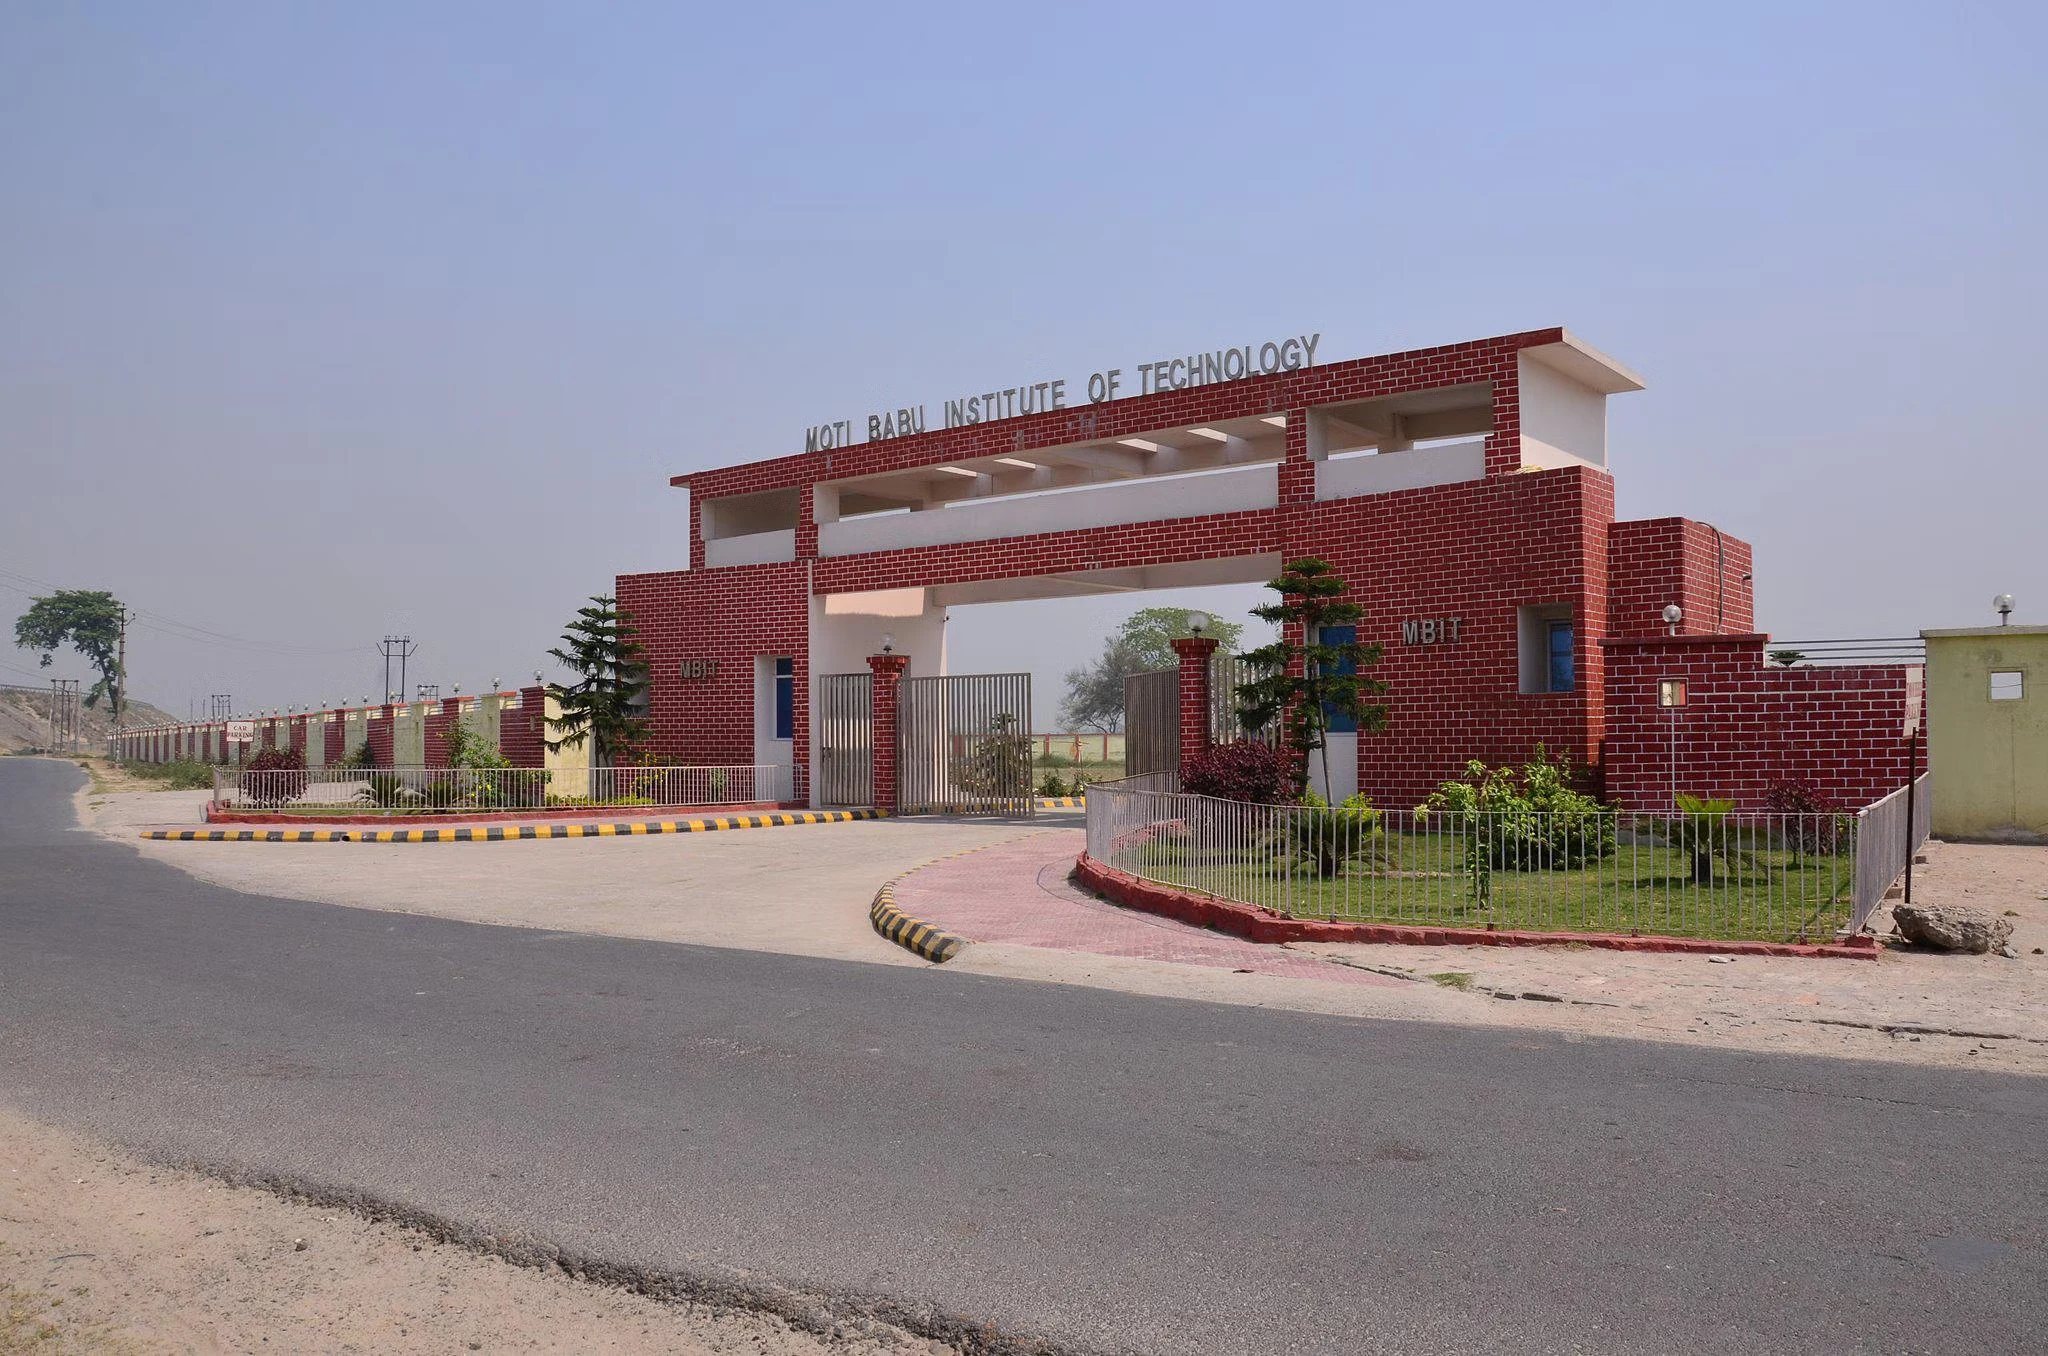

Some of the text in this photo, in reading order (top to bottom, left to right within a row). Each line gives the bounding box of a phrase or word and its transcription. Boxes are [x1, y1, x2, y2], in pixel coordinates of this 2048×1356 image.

[805, 333, 1320, 453] MOTI BABU INSTITUTE OF TECHNOLOGY
[1402, 616, 1462, 645] MBIT
[680, 659, 719, 678] MBIT
